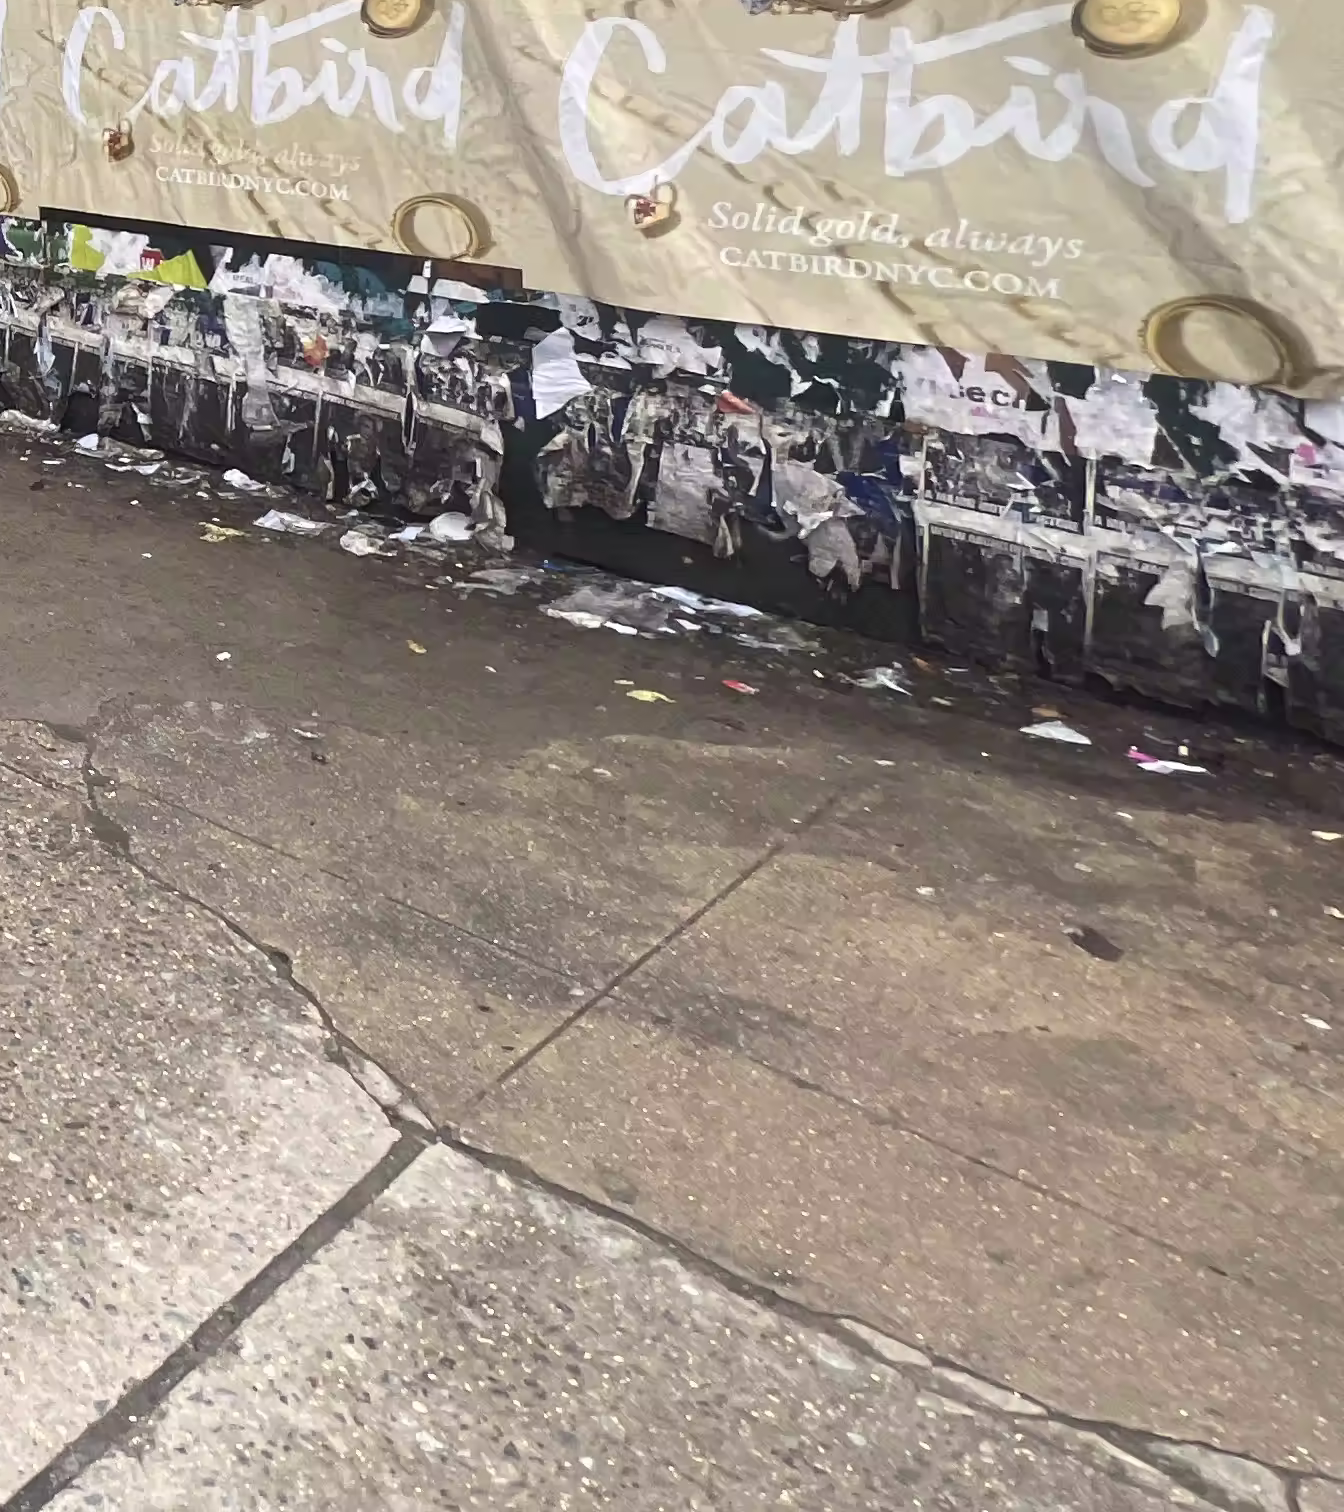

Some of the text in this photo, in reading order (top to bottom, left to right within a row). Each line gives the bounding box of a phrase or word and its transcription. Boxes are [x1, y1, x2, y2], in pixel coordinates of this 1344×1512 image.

[558, 4, 1276, 223] Catbird
[155, 166, 350, 202] CATBIRDNYC.COM
[708, 201, 1085, 267] Solid gold, always
[719, 246, 1063, 299] CATBIRDNYC.COM
